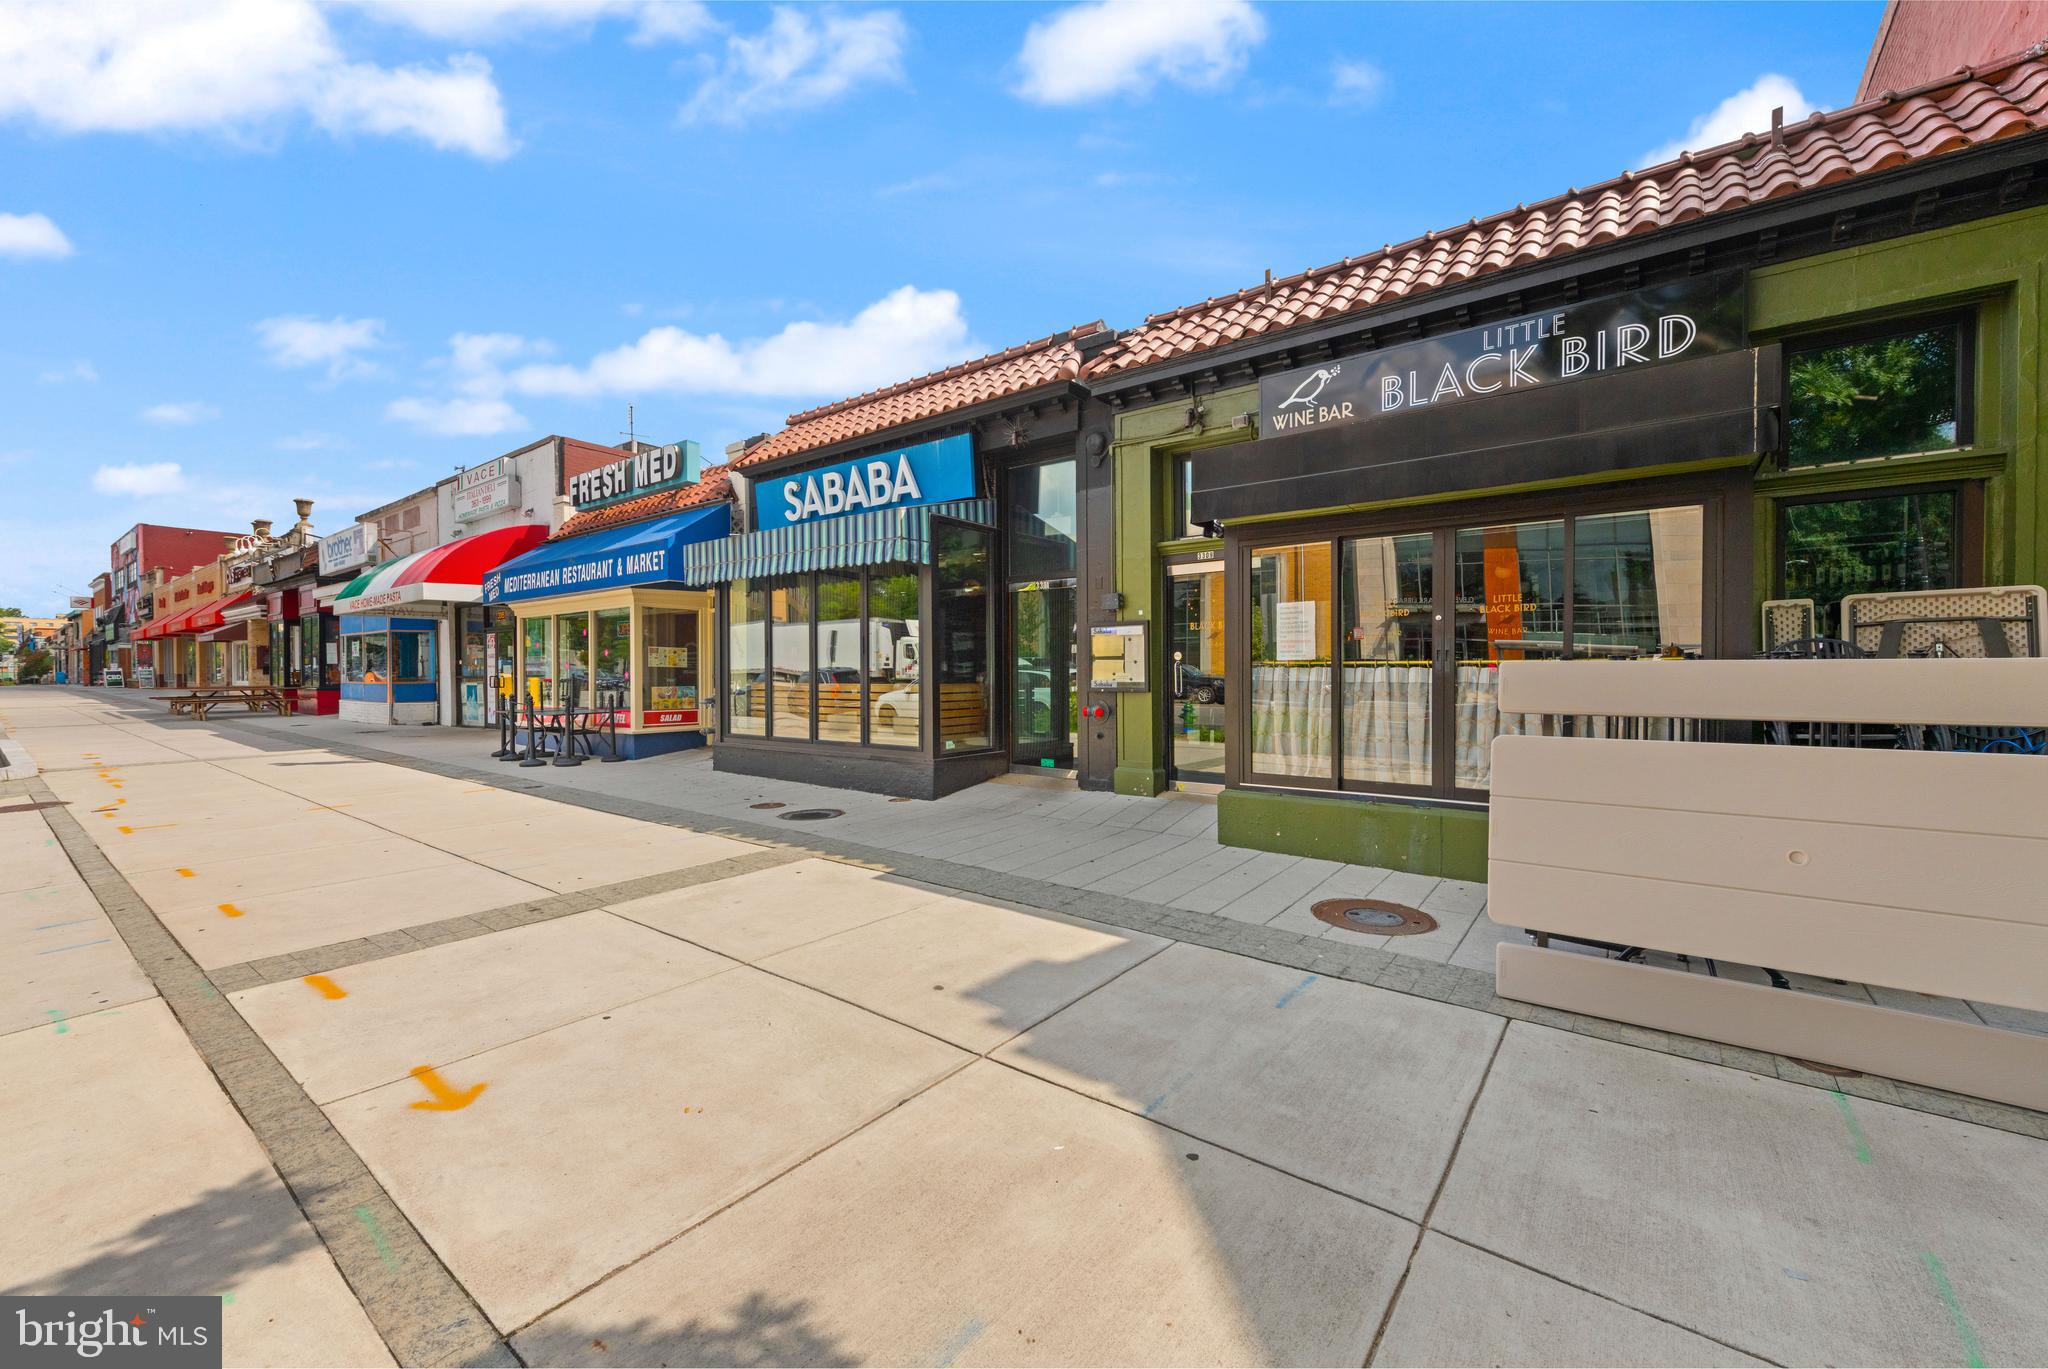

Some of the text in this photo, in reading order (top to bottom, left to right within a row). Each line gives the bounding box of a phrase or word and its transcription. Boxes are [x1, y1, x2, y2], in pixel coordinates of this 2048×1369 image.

[1484, 313, 1566, 351] LITTLE
[1381, 314, 1697, 412] BLACK BIRD
[1272, 402, 1355, 431] WINE BAR
[467, 465, 495, 485] VACE
[569, 445, 678, 506] FRESH MED
[783, 453, 922, 522] SABABA
[484, 572, 501, 594] FRESH
[504, 550, 666, 594] MEDITERRANEAN RESTAURANT & MARKET
[387, 590, 401, 601] PASTA
[488, 586, 500, 601] MED
[1493, 593, 1523, 603] LITTLE
[1479, 603, 1537, 614] BLACK BIRD
[660, 714, 683, 722] SALAD
